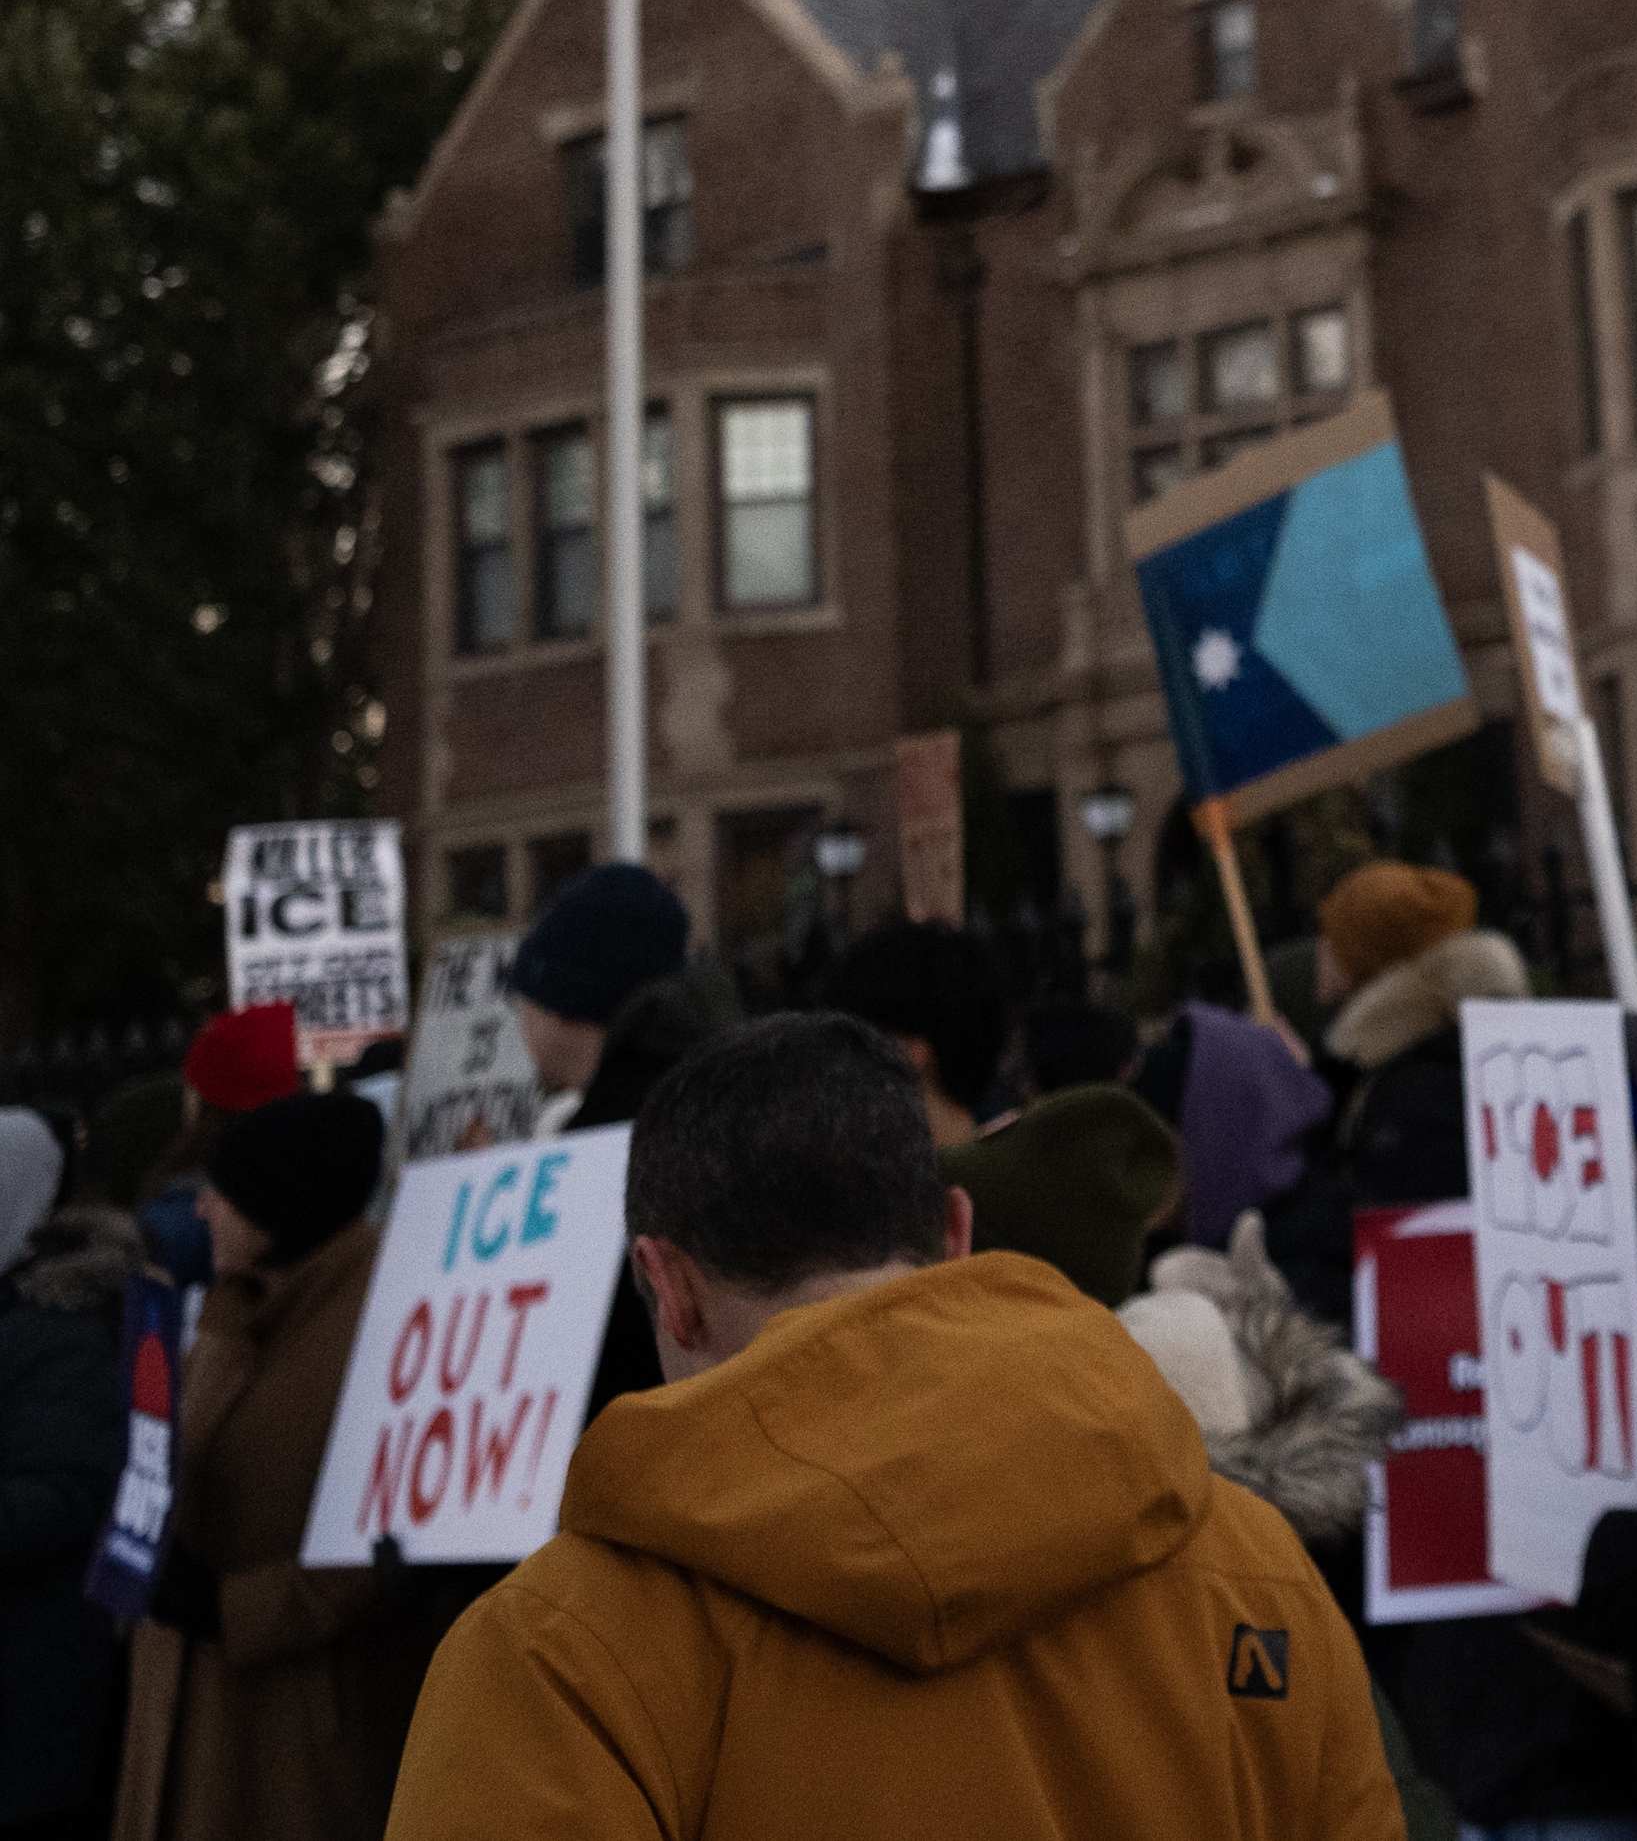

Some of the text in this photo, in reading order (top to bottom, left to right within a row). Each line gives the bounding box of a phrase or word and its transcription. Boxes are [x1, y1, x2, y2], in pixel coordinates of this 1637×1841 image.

[240, 884, 392, 940] ICE
[440, 1150, 571, 1276] ICE
[386, 1278, 551, 1408] OUT
[355, 1384, 560, 1534] NOW!
